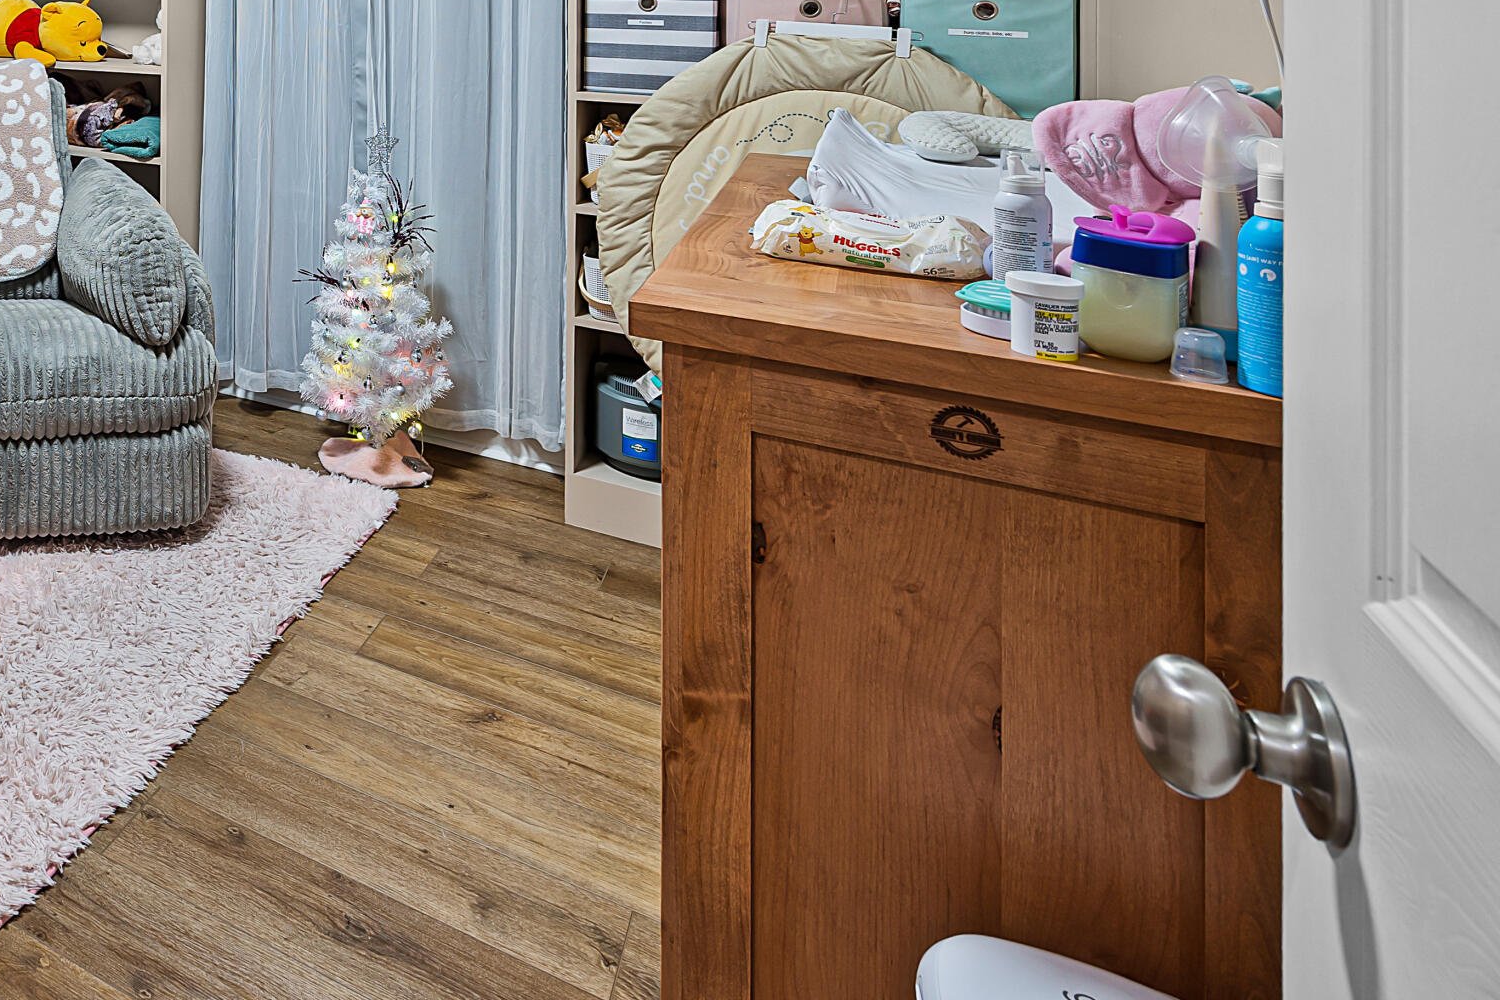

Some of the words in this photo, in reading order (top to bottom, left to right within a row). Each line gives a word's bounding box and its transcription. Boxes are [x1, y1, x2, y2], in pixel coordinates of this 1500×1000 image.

[833, 234, 901, 257] HUGGIES
[841, 247, 872, 260] natural
[872, 254, 891, 264] care
[923, 267, 937, 275] 56
